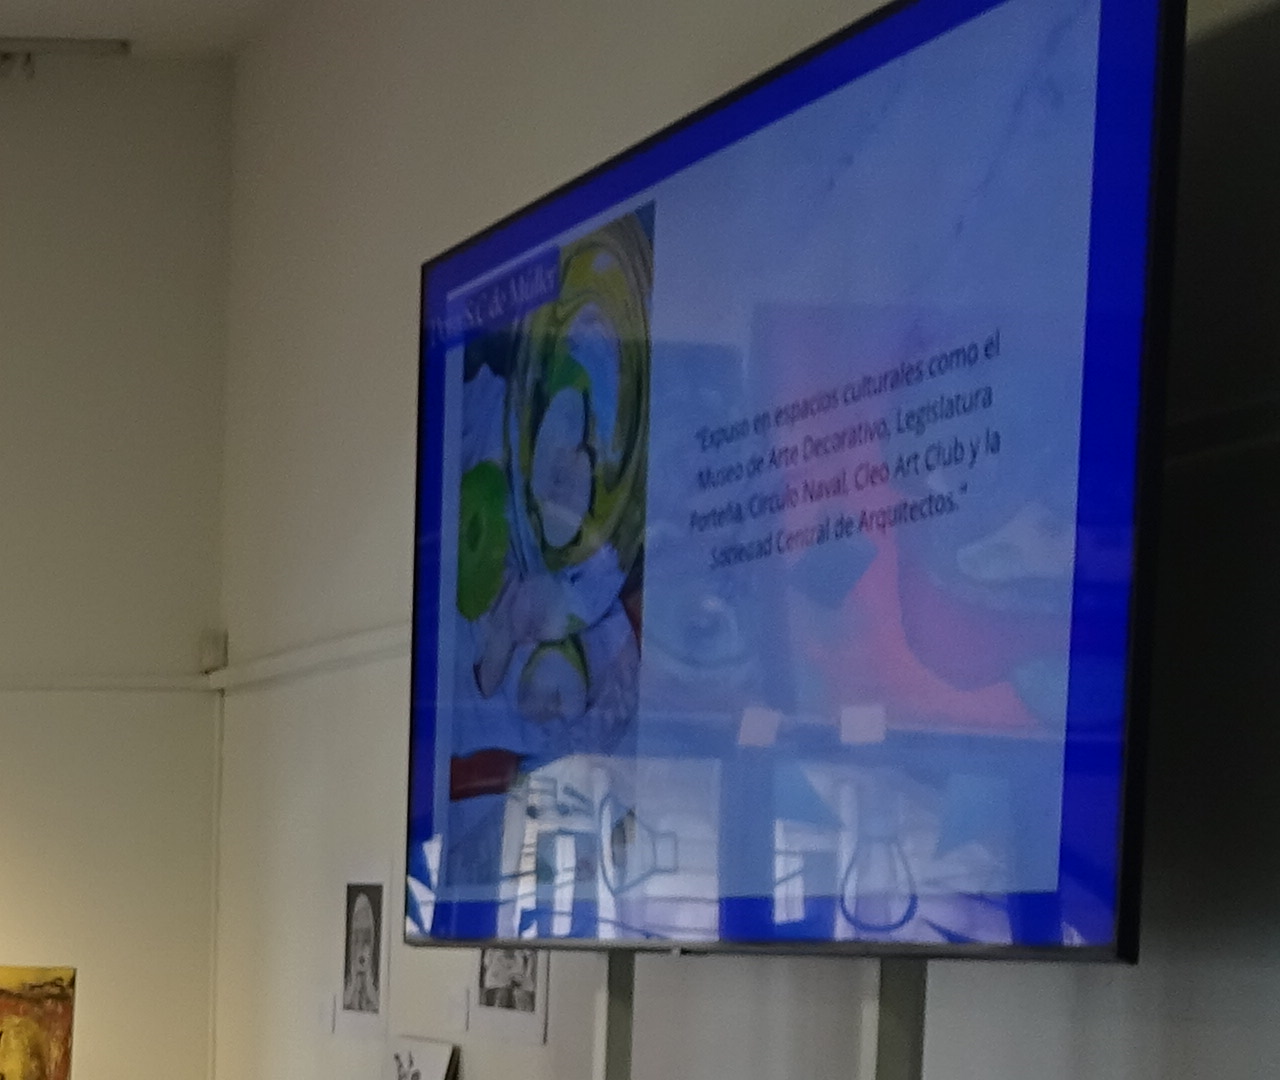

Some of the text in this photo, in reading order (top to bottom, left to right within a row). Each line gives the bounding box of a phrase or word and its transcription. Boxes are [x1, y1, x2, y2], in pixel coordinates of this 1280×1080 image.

[753, 411, 772, 436] en
[774, 387, 839, 428] espacios
[843, 360, 924, 406] culturales
[928, 340, 979, 378] como
[983, 328, 1001, 360] el
[746, 452, 765, 479] de
[769, 445, 799, 470] Arte
[895, 386, 994, 438] Legislatura
[854, 461, 890, 491] Cleo
[893, 452, 920, 479] Art
[924, 434, 966, 472] Club
[984, 425, 1001, 455] la
[834, 512, 856, 541] de
